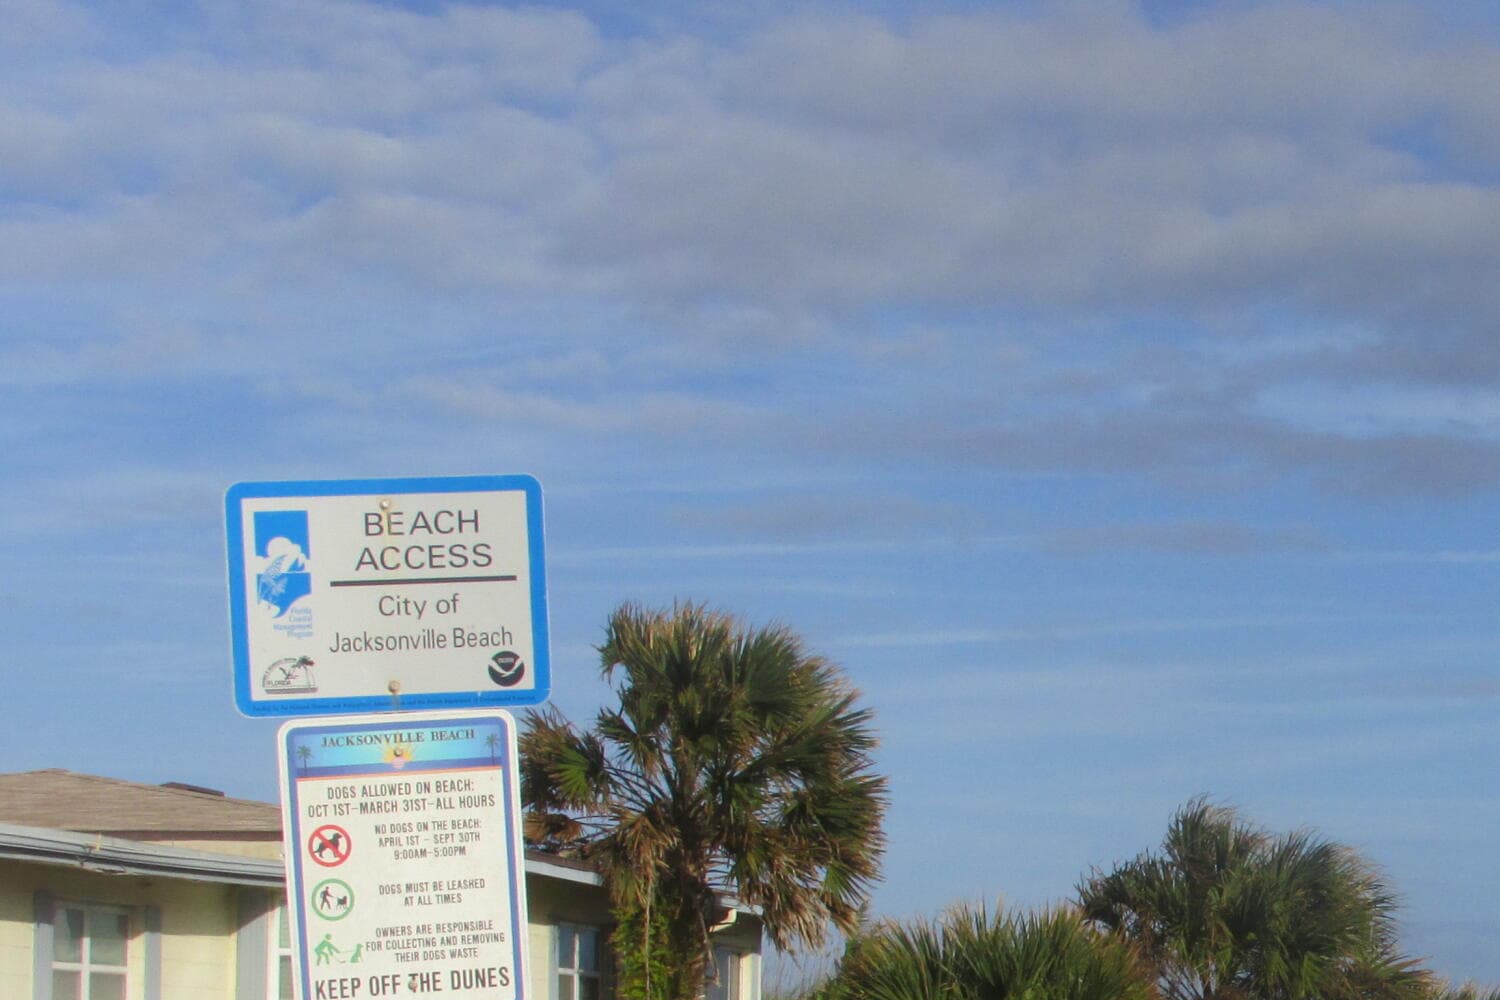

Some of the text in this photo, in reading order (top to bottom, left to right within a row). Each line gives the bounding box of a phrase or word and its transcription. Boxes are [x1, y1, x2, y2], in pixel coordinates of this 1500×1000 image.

[364, 509, 479, 536] BEACH
[355, 544, 493, 571] ACCESS
[379, 593, 460, 619] City of
[329, 626, 513, 653] Jacksonville Beach
[321, 729, 474, 747] JACKSONVILLE BEACH
[328, 779, 474, 800] DOGS ALLOWED ON BEACH:
[309, 805, 330, 817] OCT
[460, 795, 495, 808] HOURS
[375, 819, 482, 834] NO DOGS ON THE BEACH:
[379, 836, 402, 847] APRIL
[405, 835, 420, 846] 1ST
[433, 833, 454, 843] SEPT
[459, 832, 480, 842] 30TH
[379, 878, 485, 895] DOGS MUST BE LEASHED
[404, 893, 462, 906] AT ALL TIMES
[376, 920, 493, 937] OWNERS ARE RESPONSIBLE
[366, 933, 505, 951] FOR COLLECTING AND REMOVING
[395, 948, 478, 963] THEIR DOGS WASTE
[315, 967, 510, 1000] KEEP OFF THE DUNES
